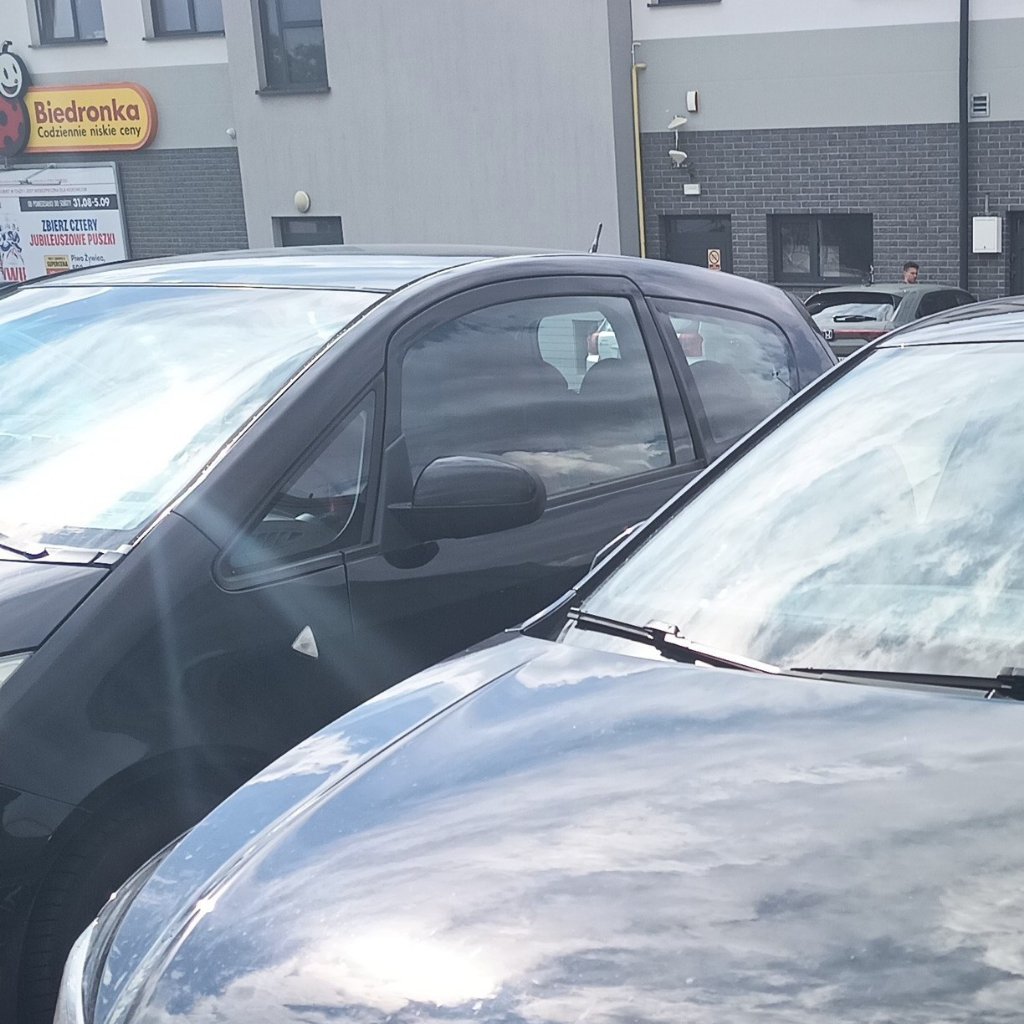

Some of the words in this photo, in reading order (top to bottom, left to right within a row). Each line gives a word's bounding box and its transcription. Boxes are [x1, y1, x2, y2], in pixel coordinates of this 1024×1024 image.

[34, 98, 140, 124] Biedronka
[37, 126, 87, 138] Codziennie
[90, 124, 117, 137] niskie
[120, 126, 141, 137] ceny
[73, 197, 110, 208] 31.08-5.09
[41, 219, 69, 232] ZBIERZ
[69, 218, 98, 231] CZTERY
[30, 233, 87, 246] JUBILEUSZOWE
[88, 232, 116, 245] PUSZKI
